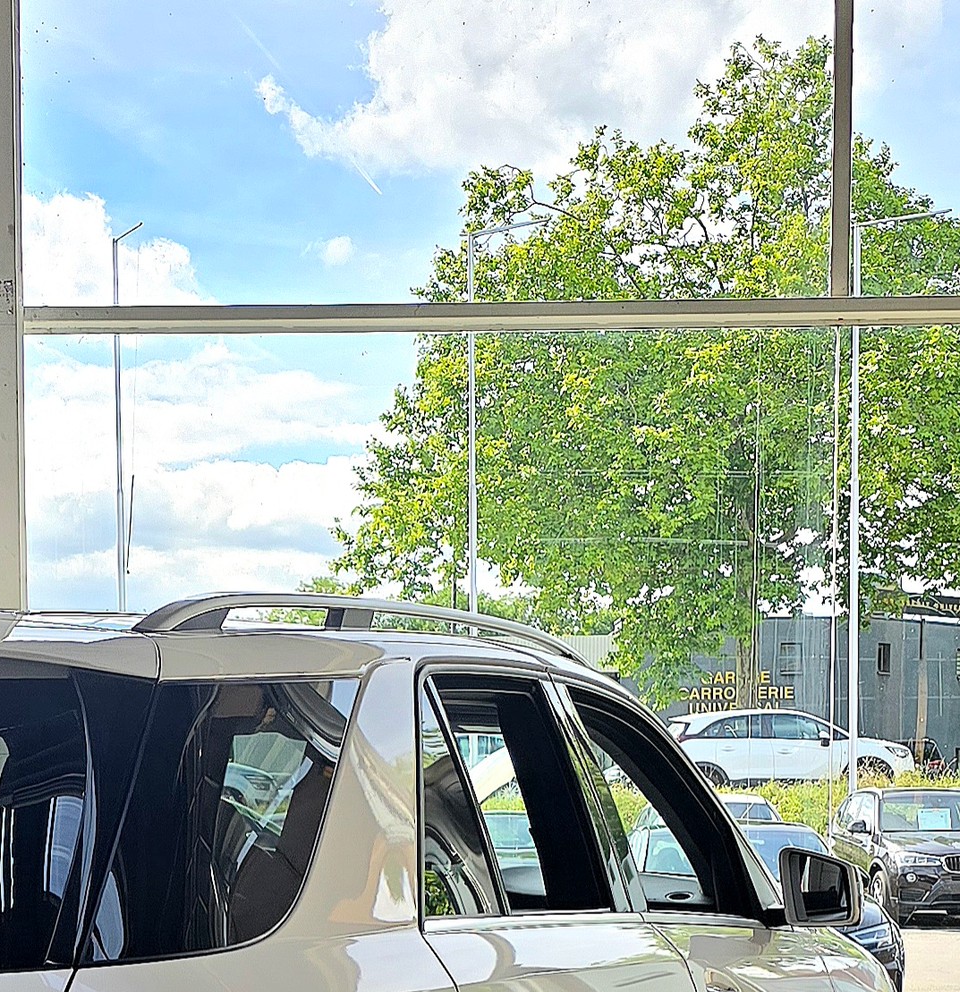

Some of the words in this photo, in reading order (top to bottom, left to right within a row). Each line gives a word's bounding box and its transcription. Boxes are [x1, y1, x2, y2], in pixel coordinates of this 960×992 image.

[701, 671, 771, 684] GARE
[678, 686, 795, 700] CARROERIE
[689, 702, 780, 715] UNIVEAL
